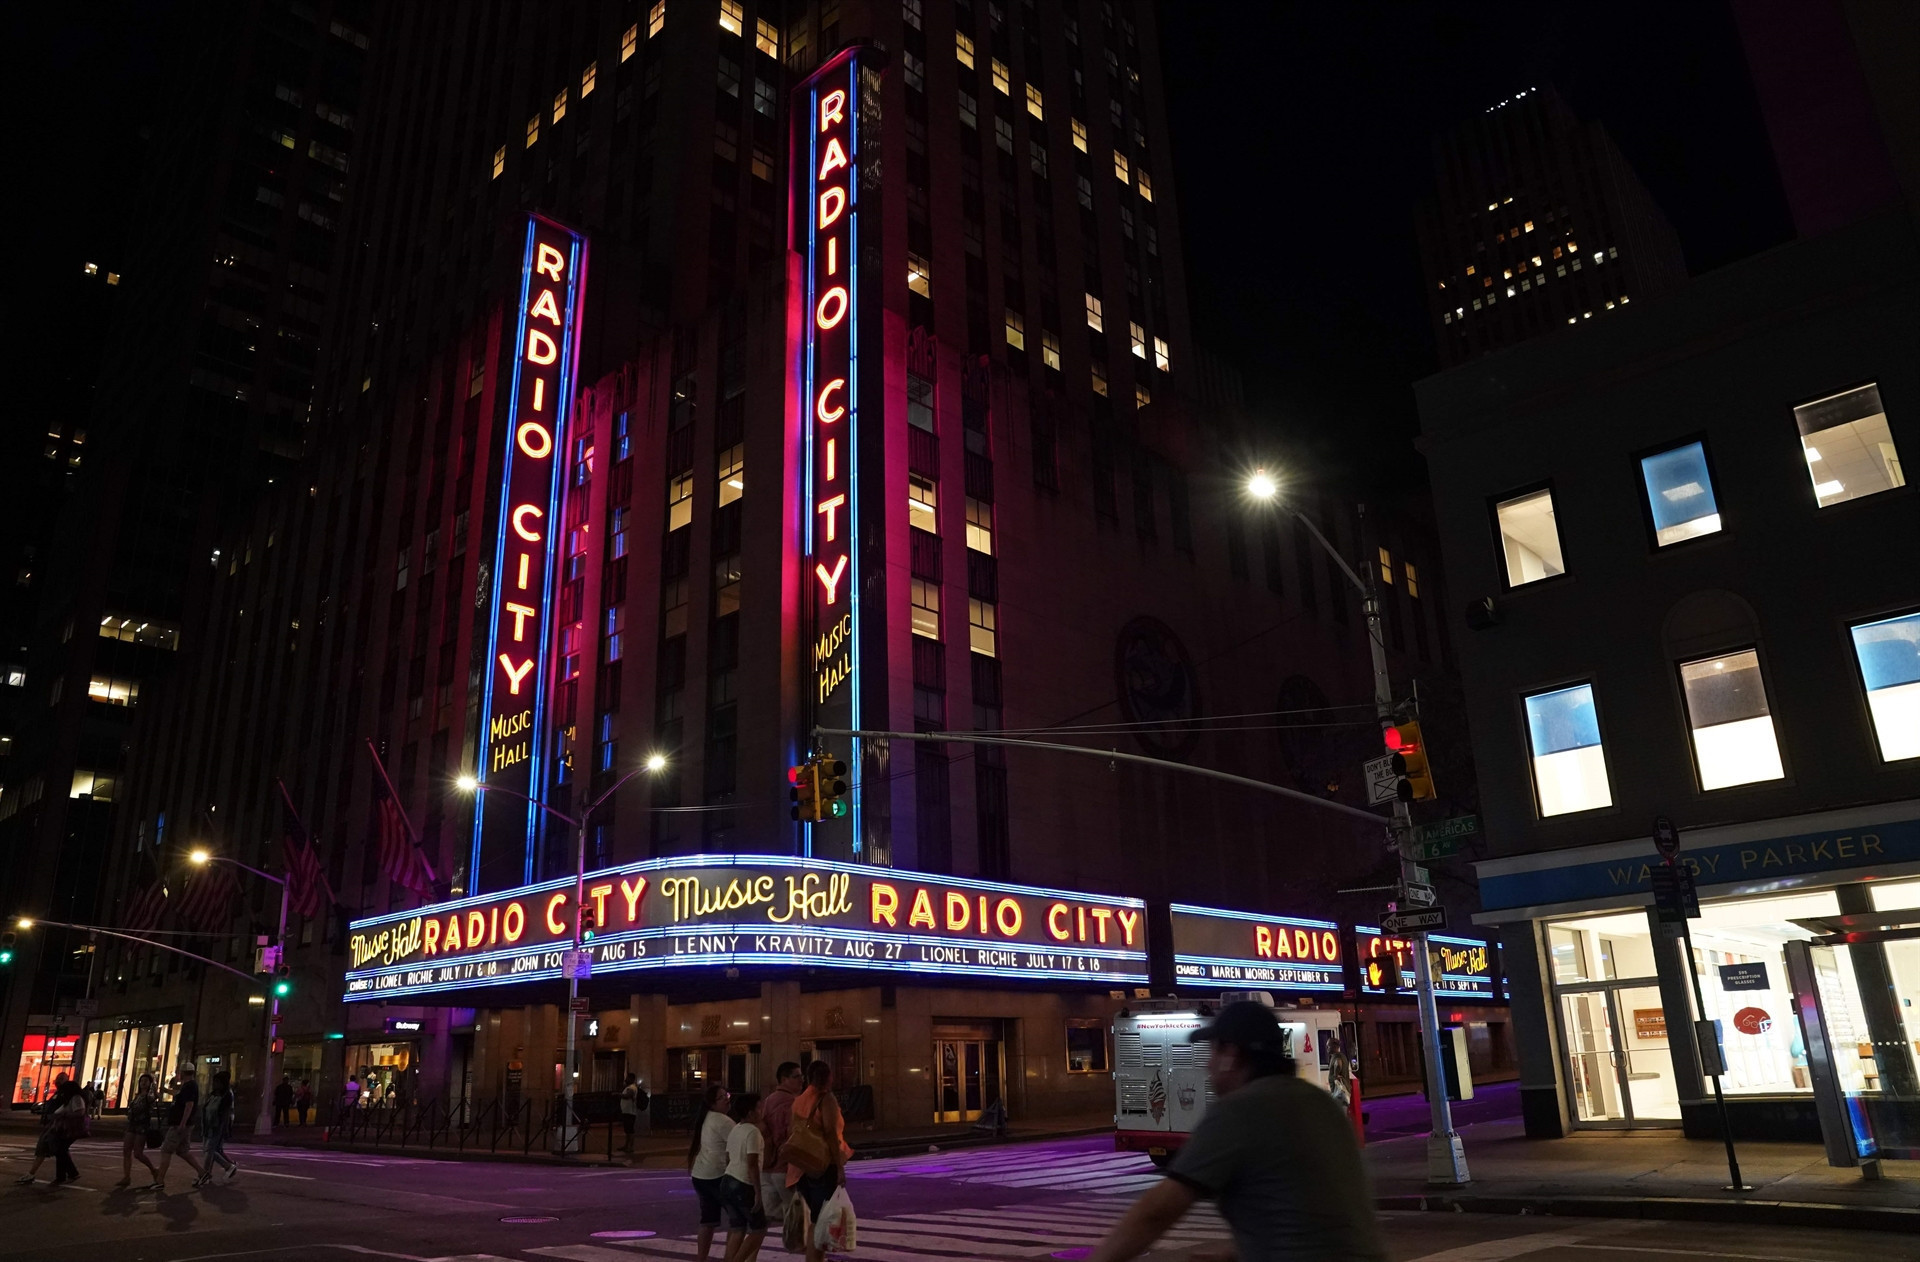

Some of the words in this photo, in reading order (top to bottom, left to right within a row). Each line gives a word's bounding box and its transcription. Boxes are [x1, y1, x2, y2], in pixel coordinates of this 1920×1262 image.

[817, 88, 849, 330] RADIO
[516, 242, 566, 460] RADIO
[815, 378, 849, 606] CITY
[498, 503, 544, 696] CITY
[490, 709, 532, 744] MUSIC
[493, 741, 529, 773] HALL
[1426, 821, 1475, 841] AMERICAS
[1431, 843, 1440, 857] 6
[1608, 853, 1721, 887] WABY
[1740, 833, 1885, 870] PARKER
[422, 901, 525, 956] RADIO
[546, 875, 648, 935] CTY
[661, 874, 774, 923] Music
[767, 872, 853, 924] Hall
[871, 882, 1023, 937] RADIO
[1048, 902, 1138, 945] CITY
[1386, 916, 1408, 930] ONE
[1418, 911, 1440, 925] WAY
[351, 931, 389, 969] Music
[383, 915, 423, 966] Hall
[375, 968, 402, 990] LIONEL
[407, 965, 433, 985] RICHIE
[438, 963, 460, 983] JULY
[465, 962, 473, 979] 17
[487, 960, 497, 976] 18
[511, 954, 538, 974] JOHN
[601, 944, 626, 962] AUG
[633, 939, 646, 957] 15
[675, 935, 740, 955] LENNY
[755, 934, 834, 955] KRAVITZ
[844, 940, 875, 959] AUG
[885, 943, 903, 960] 27
[921, 946, 970, 965] LIONEL
[978, 949, 1018, 968] RICHIE
[1026, 954, 1055, 970] JULY
[1062, 955, 1072, 970] 17
[1089, 956, 1100, 972] 18
[1255, 925, 1338, 962] RADIO
[1176, 965, 1200, 976] CHASE
[1212, 965, 1241, 979] MAREN
[1245, 967, 1275, 981] MORRIS
[1279, 969, 1322, 983] SEPTEMBER
[1323, 972, 1330, 984] 6
